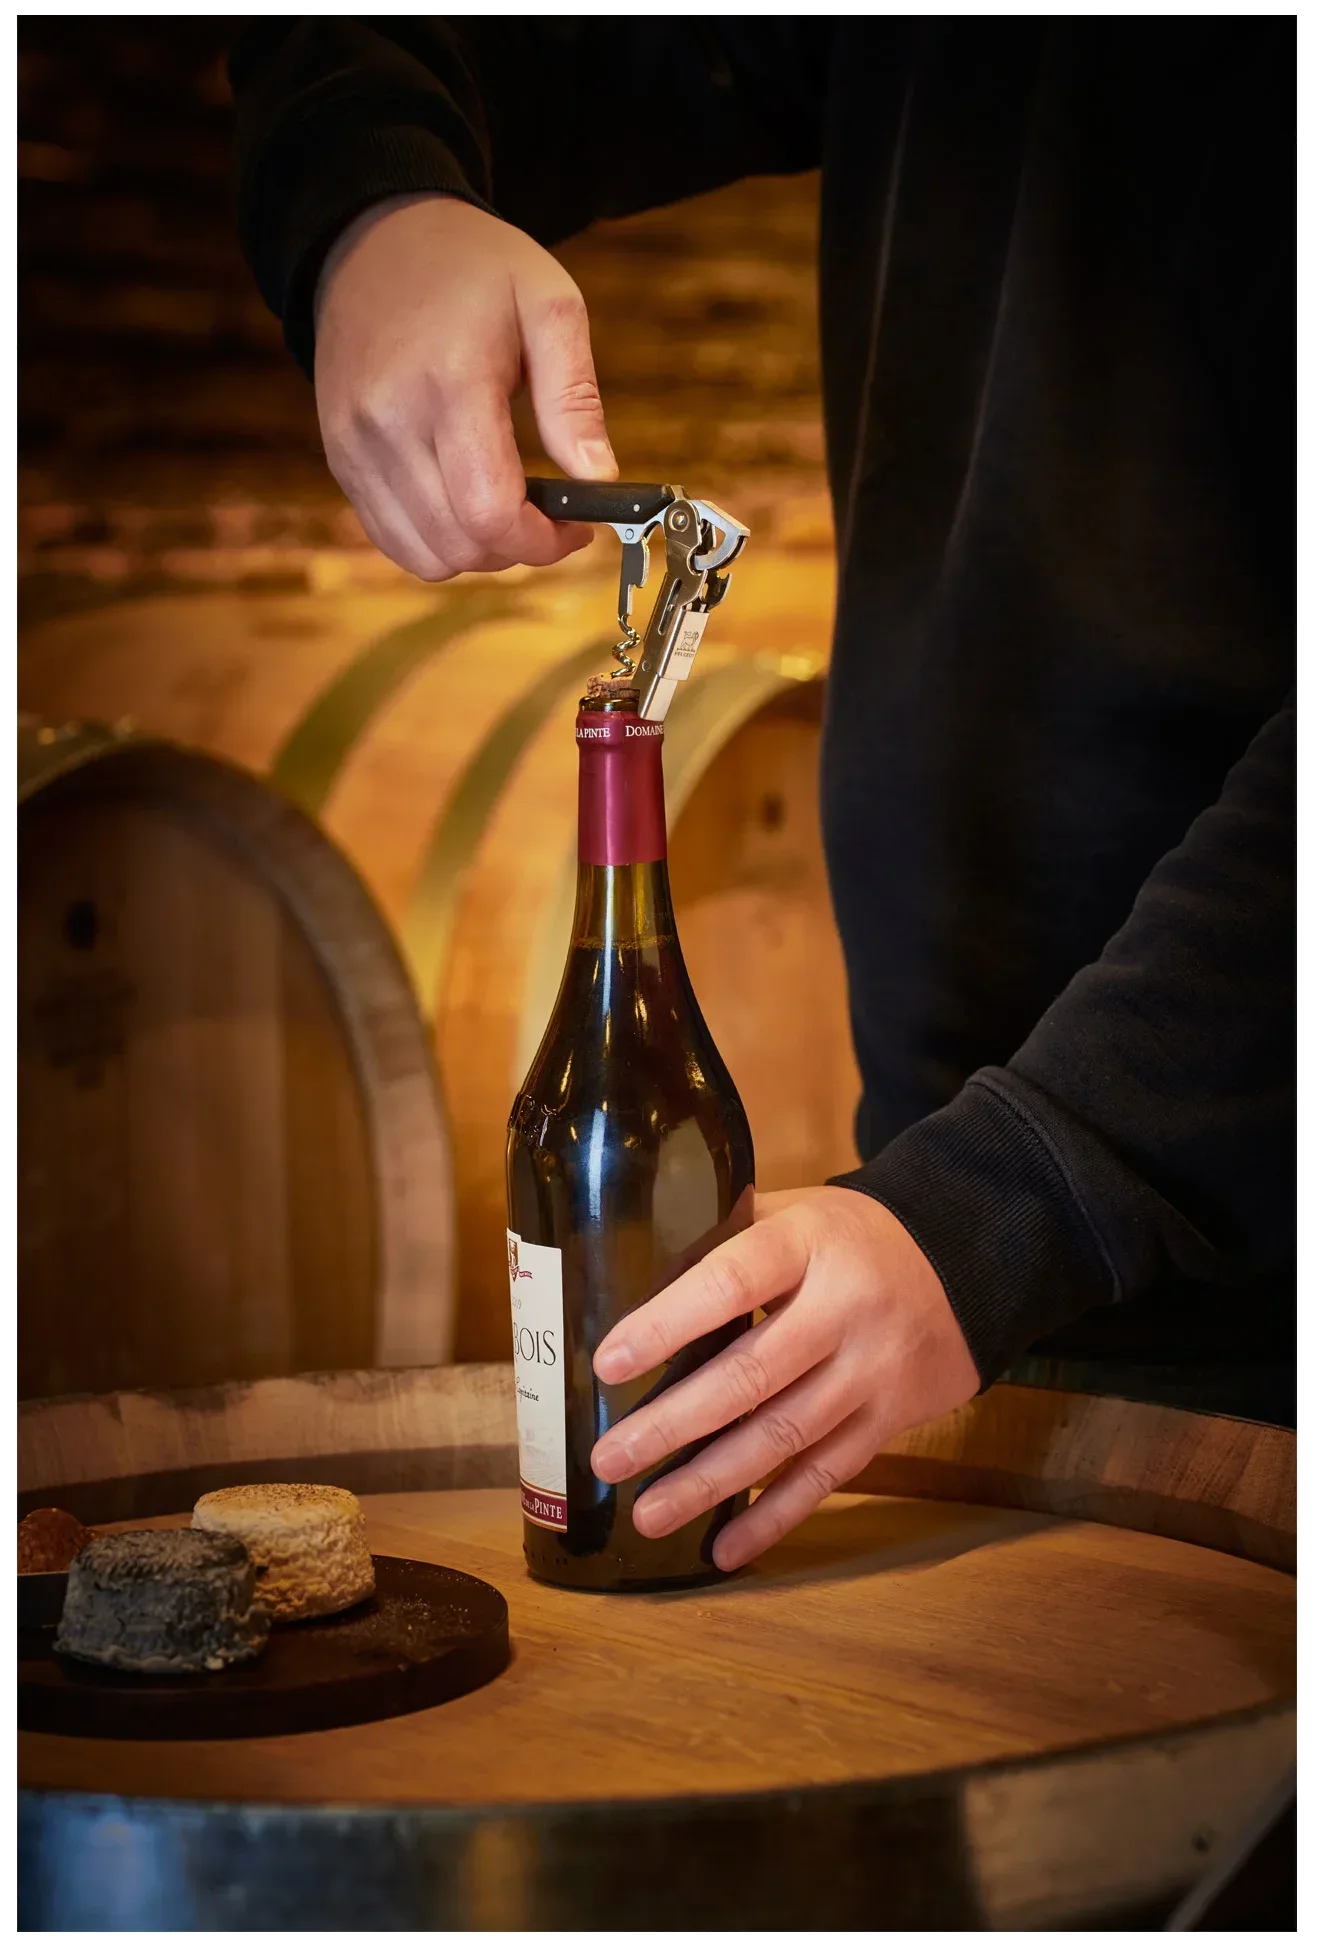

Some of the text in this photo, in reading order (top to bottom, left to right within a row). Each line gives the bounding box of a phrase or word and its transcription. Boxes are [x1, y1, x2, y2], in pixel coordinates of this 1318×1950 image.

[584, 727, 611, 738] PINTE
[625, 725, 664, 737] DOMAINE
[534, 1497, 563, 1520] PINTE
